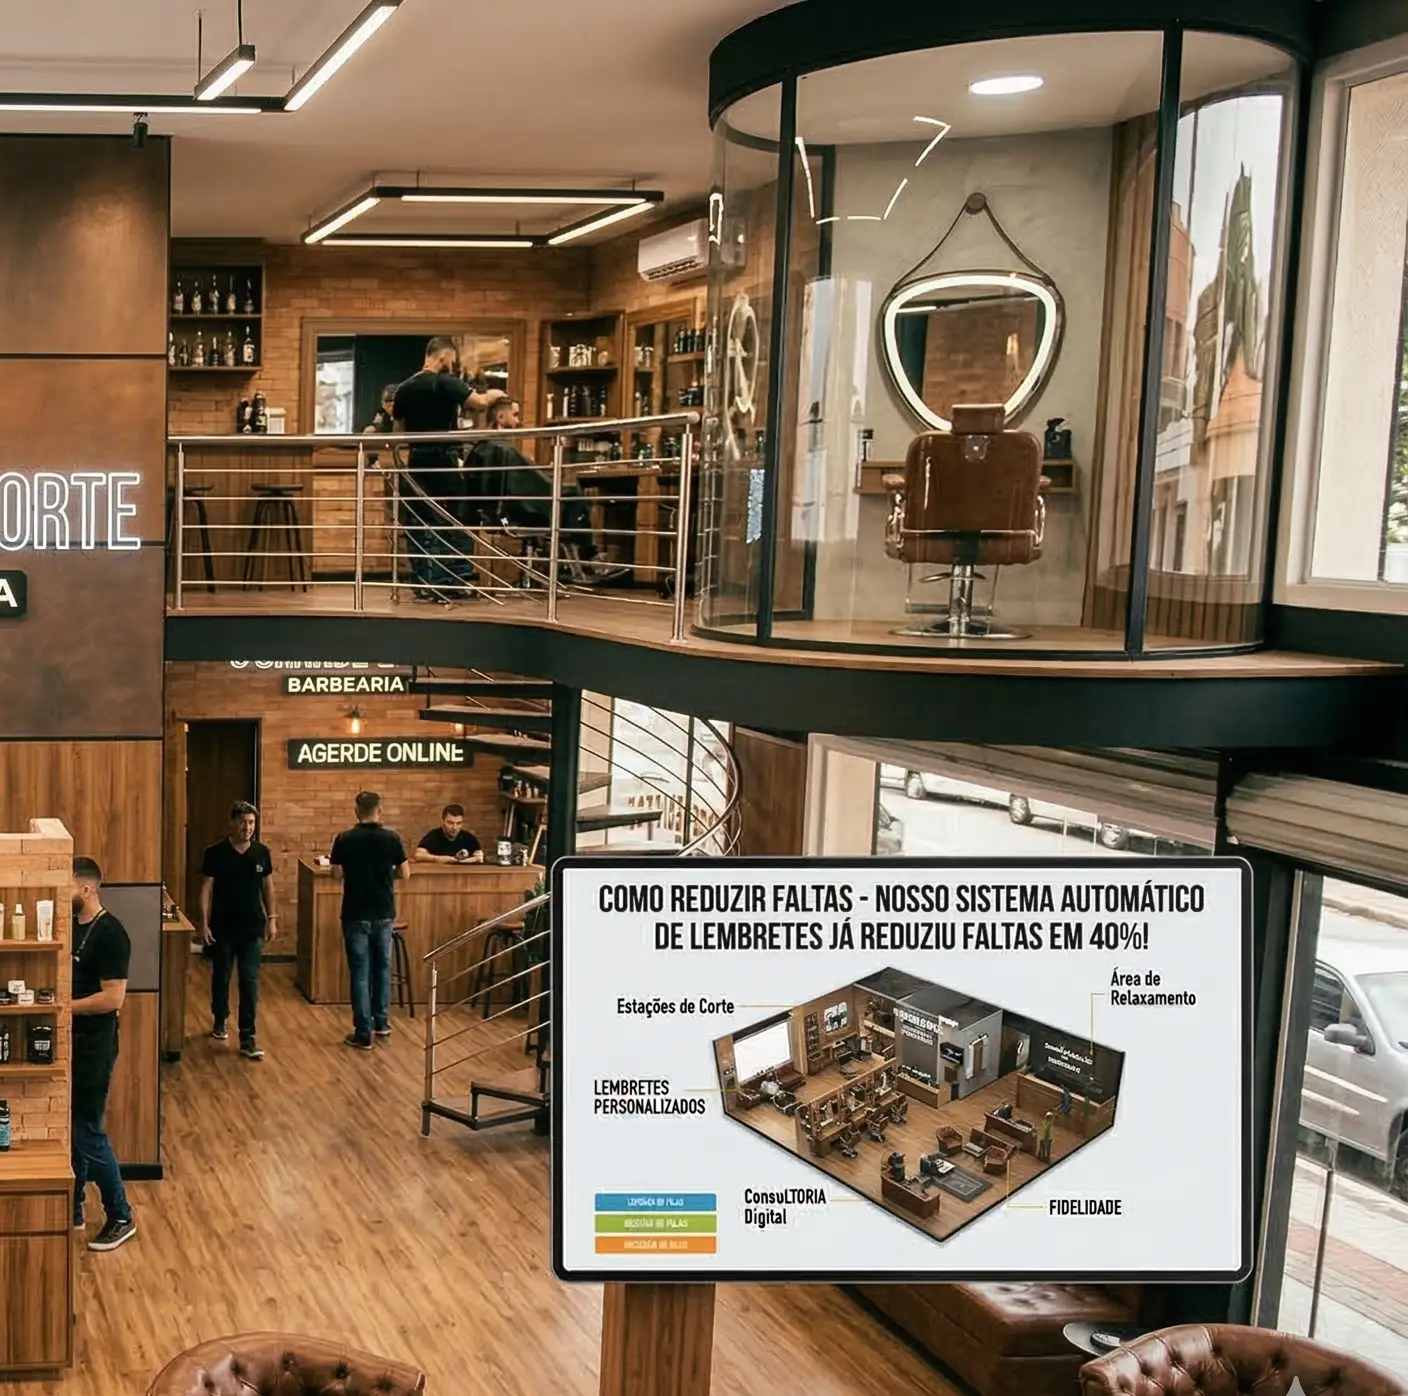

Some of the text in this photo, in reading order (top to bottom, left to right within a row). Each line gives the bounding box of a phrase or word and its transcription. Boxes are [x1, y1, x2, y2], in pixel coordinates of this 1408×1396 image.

[287, 676, 405, 693] BARBEARIA
[297, 742, 464, 763] AGERDE ONLINE
[599, 884, 664, 913] COMO
[671, 884, 767, 913] REDUZIR
[773, 884, 853, 913] FALTAS
[876, 884, 949, 913] NOSSO
[955, 884, 1054, 913] SISTEMA
[1060, 879, 1205, 913] AUTOMÁTICO
[655, 917, 1149, 950] DE LEMBRETES JÁ REDUZIU FALTAS EM 40%!
[1111, 967, 1161, 986] Área de
[1111, 989, 1197, 1006] Relaxamento
[617, 997, 735, 1019] Estações de Corte
[594, 1080, 669, 1096] LEMBRETES
[594, 1099, 706, 1115] PERSONALIZADOS
[744, 1188, 826, 1205] ConsuLTORIA
[1049, 1199, 1122, 1216] FIDELIDADE
[744, 1208, 787, 1229] Digital
